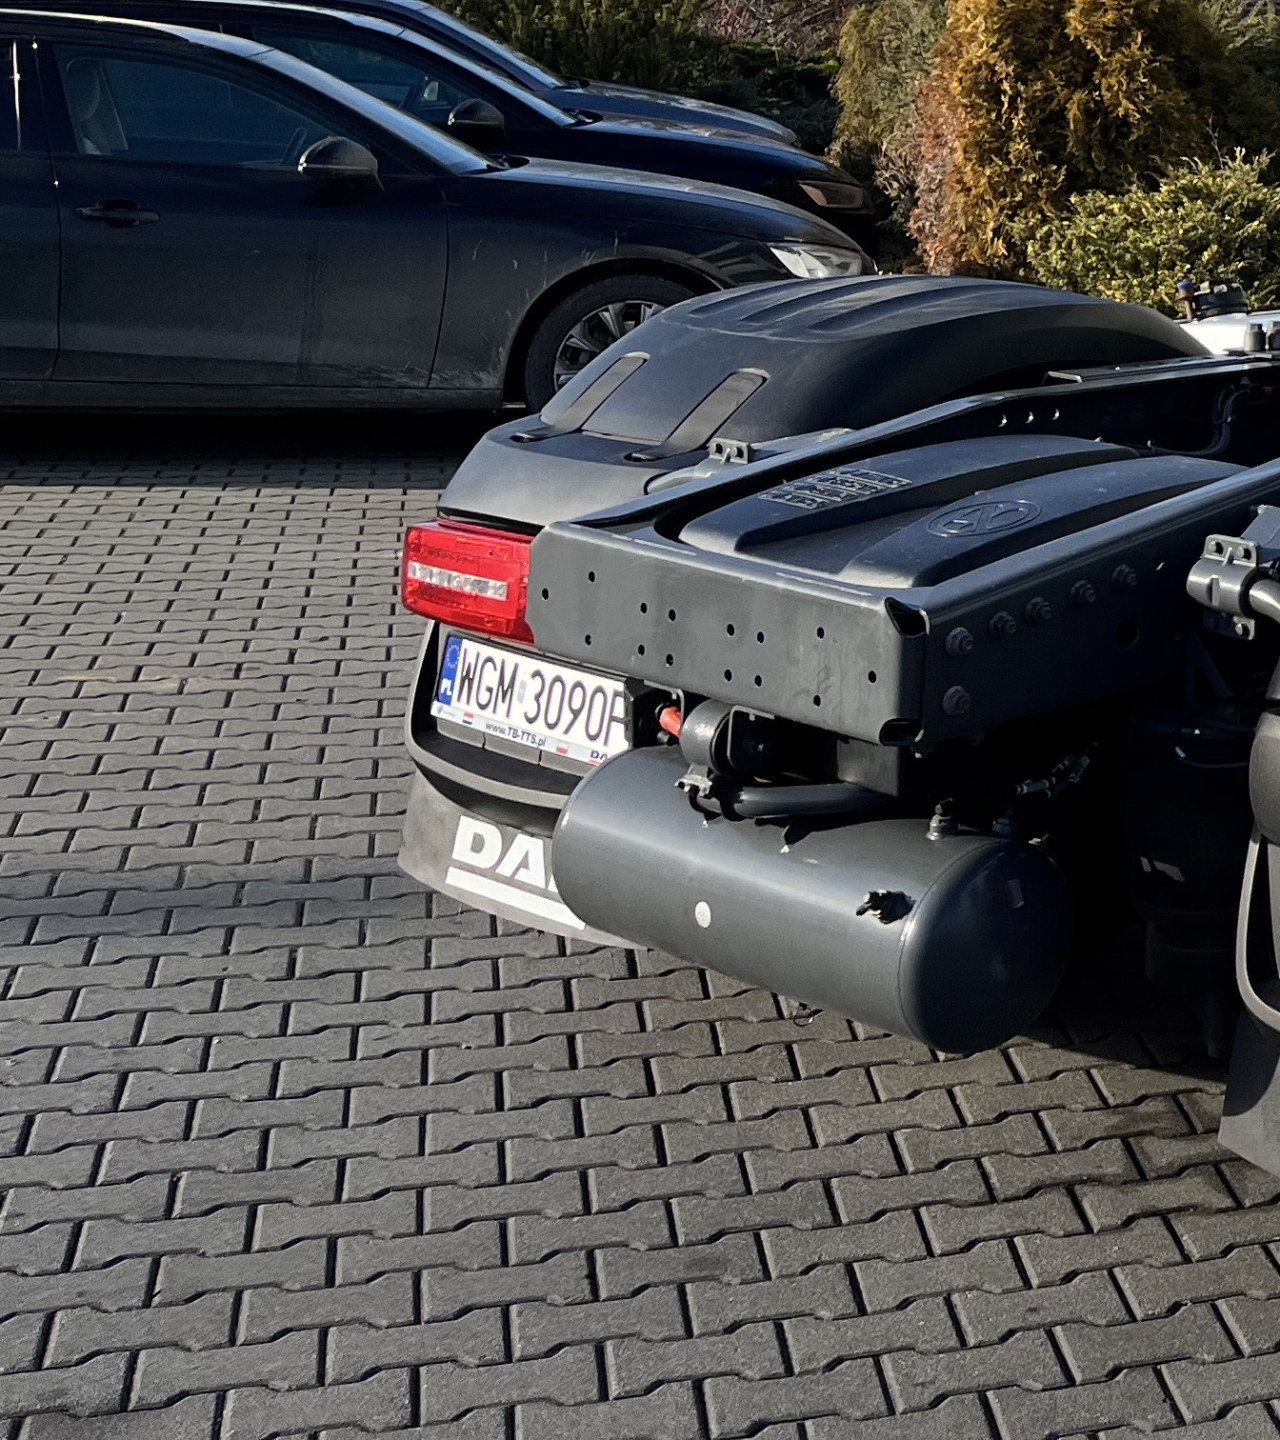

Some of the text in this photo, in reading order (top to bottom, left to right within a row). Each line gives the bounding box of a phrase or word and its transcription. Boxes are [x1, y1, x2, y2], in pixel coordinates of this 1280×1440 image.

[440, 678, 452, 696] PL
[457, 648, 519, 718] WGM
[452, 815, 558, 893] DA
